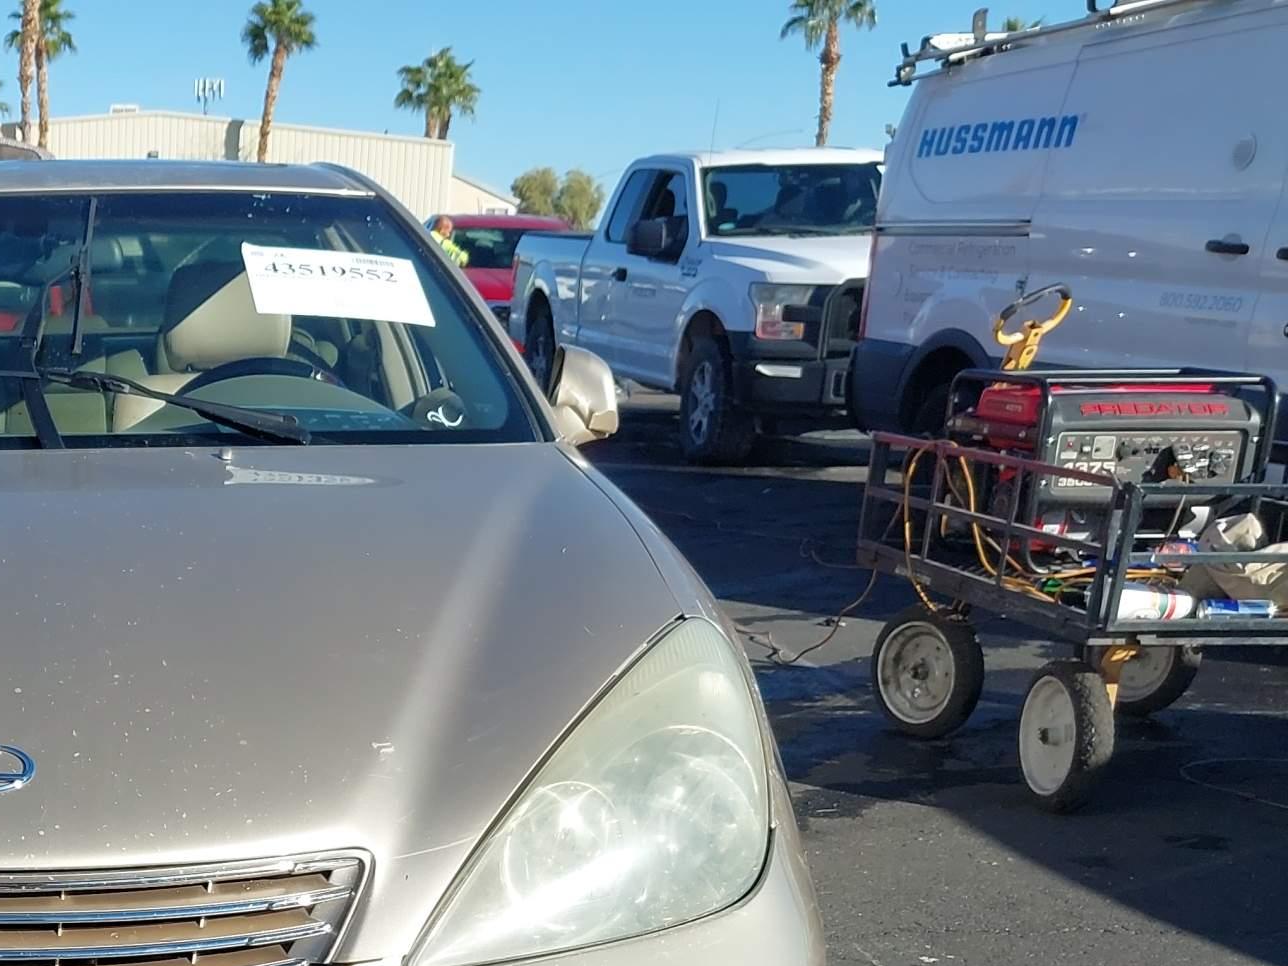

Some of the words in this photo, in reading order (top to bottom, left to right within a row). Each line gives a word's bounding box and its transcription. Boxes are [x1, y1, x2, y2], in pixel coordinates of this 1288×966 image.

[917, 115, 1079, 158] HUSSMANN
[264, 261, 398, 283] 43519552
[1080, 403, 1230, 416] PREDATOR
